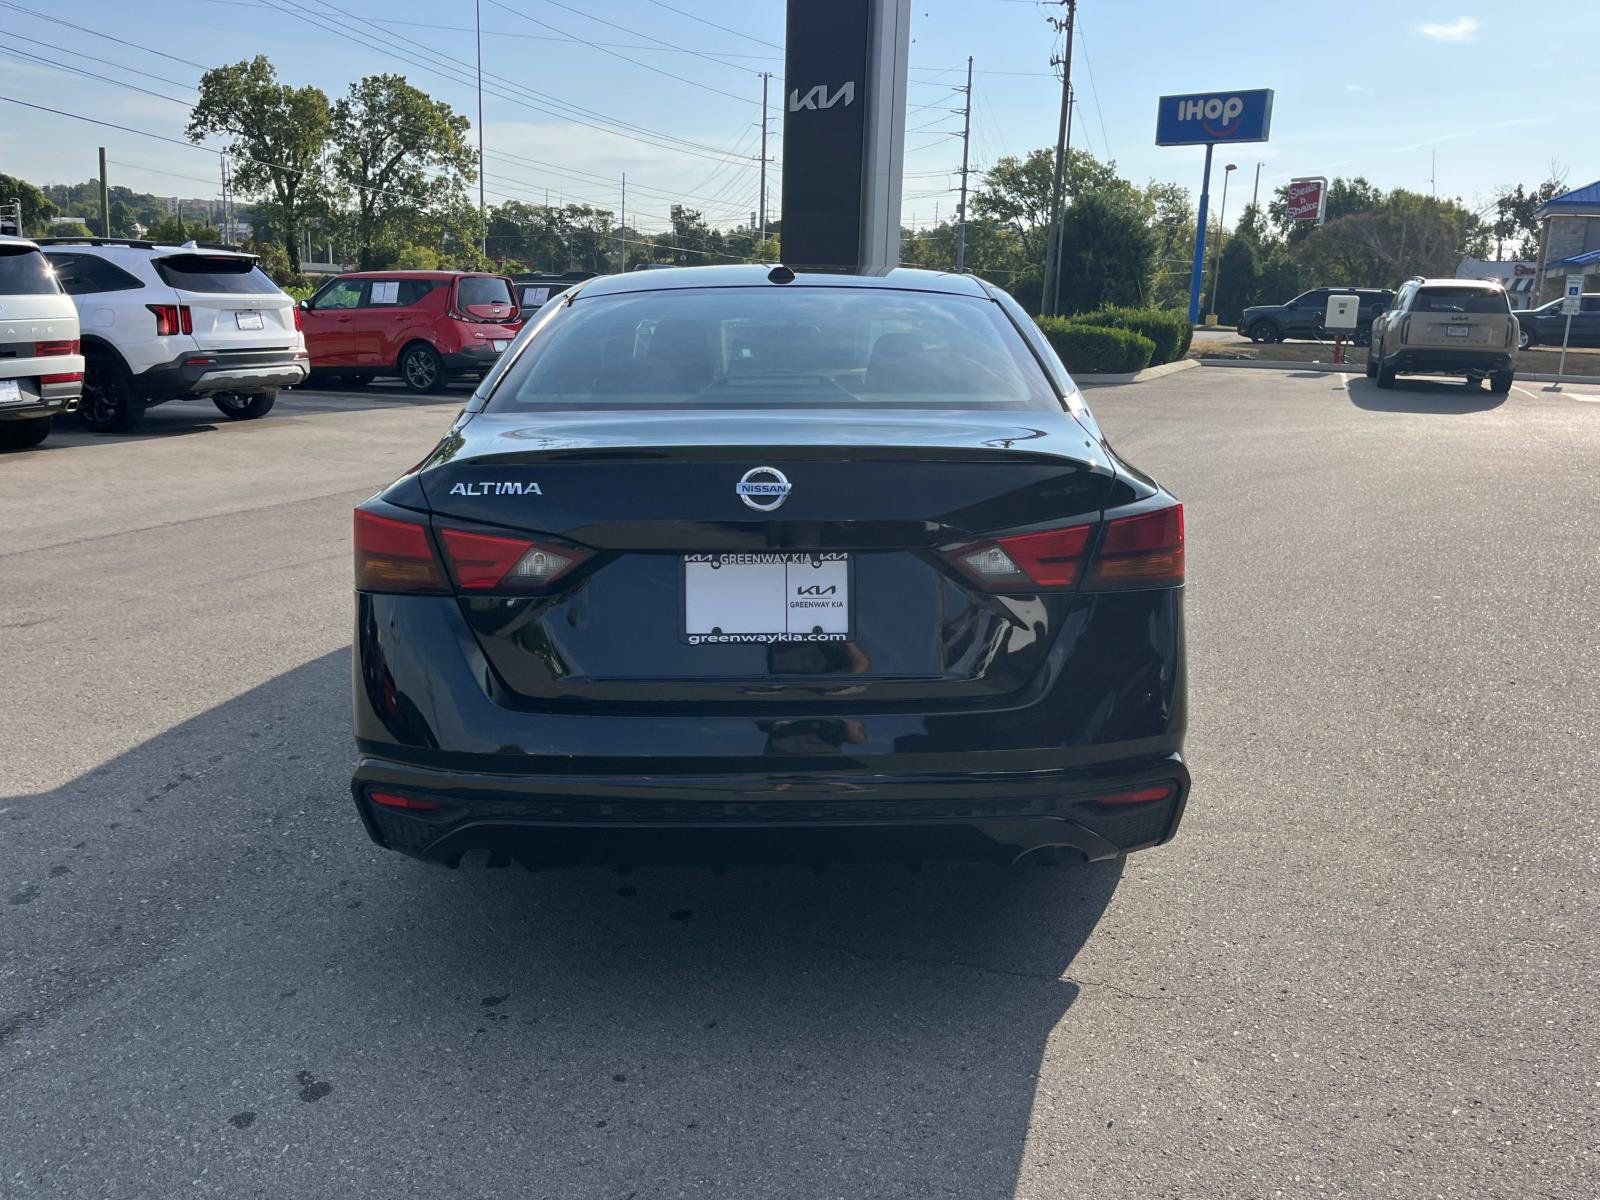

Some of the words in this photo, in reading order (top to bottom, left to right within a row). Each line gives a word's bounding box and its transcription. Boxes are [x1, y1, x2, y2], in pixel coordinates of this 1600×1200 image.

[1177, 97, 1244, 126] IHOP
[449, 482, 543, 496] ALTIMA
[741, 485, 786, 493] NISSAN
[719, 553, 789, 565] GREENWAY
[792, 553, 813, 565] KIA
[688, 632, 847, 645] greenwaykia.com
